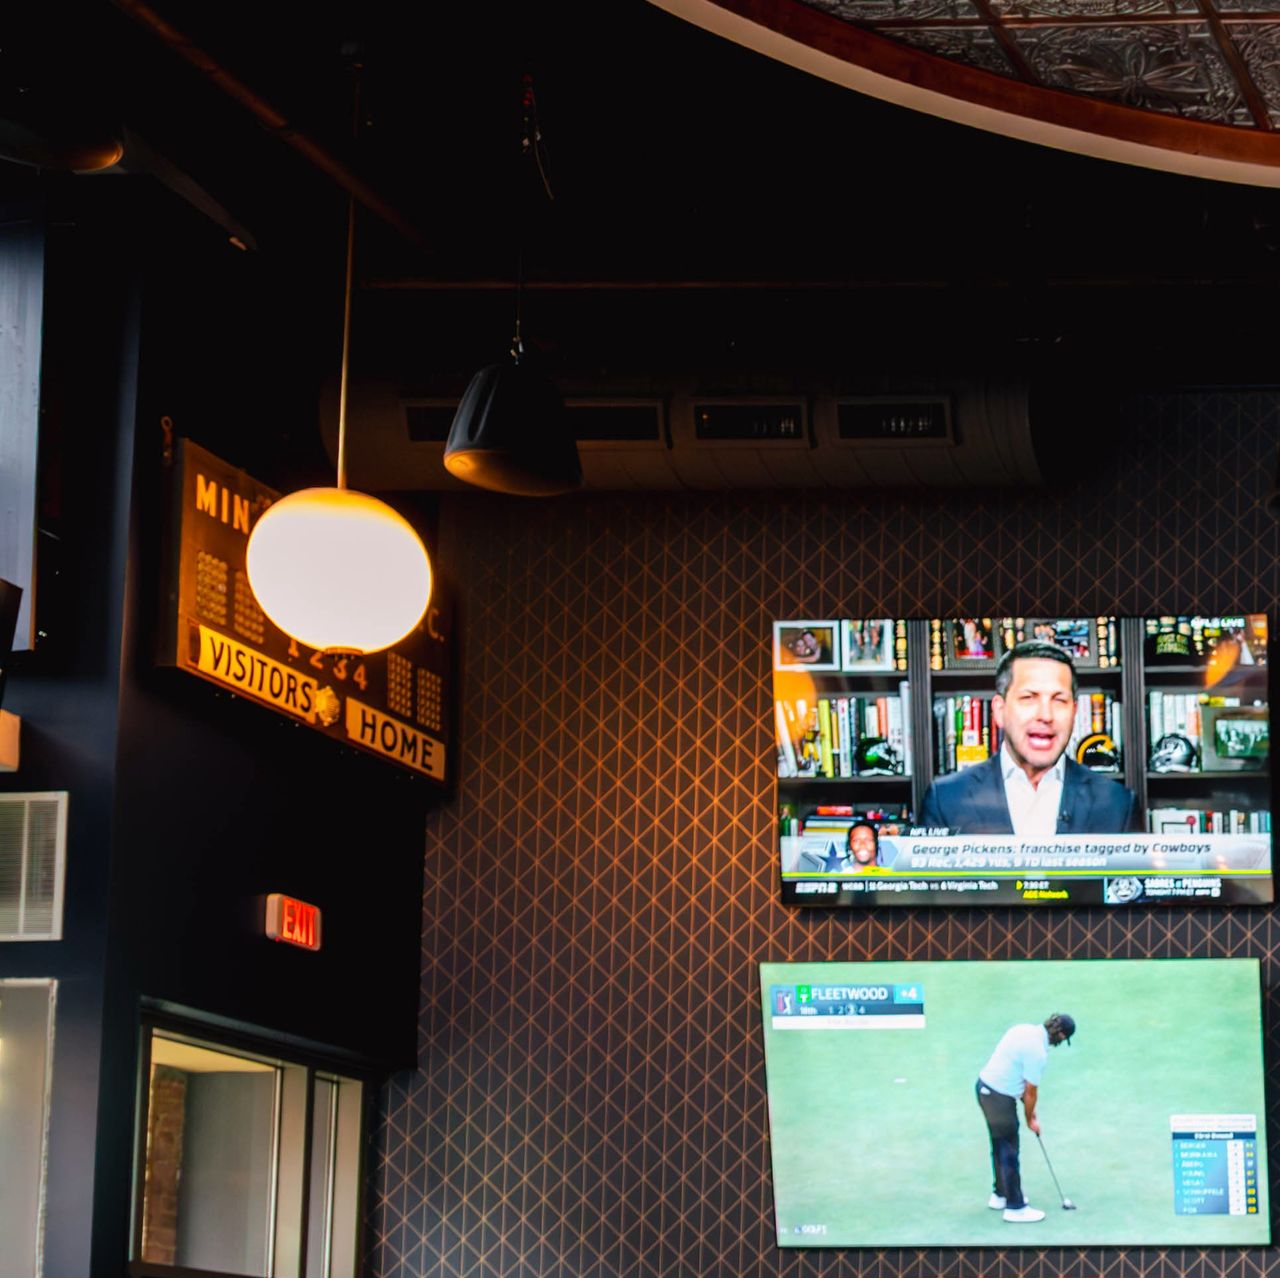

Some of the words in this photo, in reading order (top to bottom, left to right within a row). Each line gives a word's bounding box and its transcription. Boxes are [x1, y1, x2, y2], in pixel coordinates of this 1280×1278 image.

[196, 474, 249, 534] MIN
[209, 636, 313, 721] VISITORS
[353, 664, 367, 690] 4
[360, 708, 434, 771] HOME
[911, 843, 958, 855] George
[1020, 843, 1081, 854] franchise
[1084, 843, 1131, 855] tagged
[1133, 842, 1149, 855] by
[1152, 842, 1212, 854] Cowboys
[1024, 856, 1040, 867] TD
[1041, 856, 1063, 867] last
[1065, 857, 1107, 867] season
[876, 881, 908, 893] Georgia
[909, 881, 929, 891] Tech
[947, 881, 979, 893] Virginia
[979, 881, 999, 891] Tech
[283, 899, 315, 946] EXIT
[811, 987, 888, 1000] FLEETWOOD
